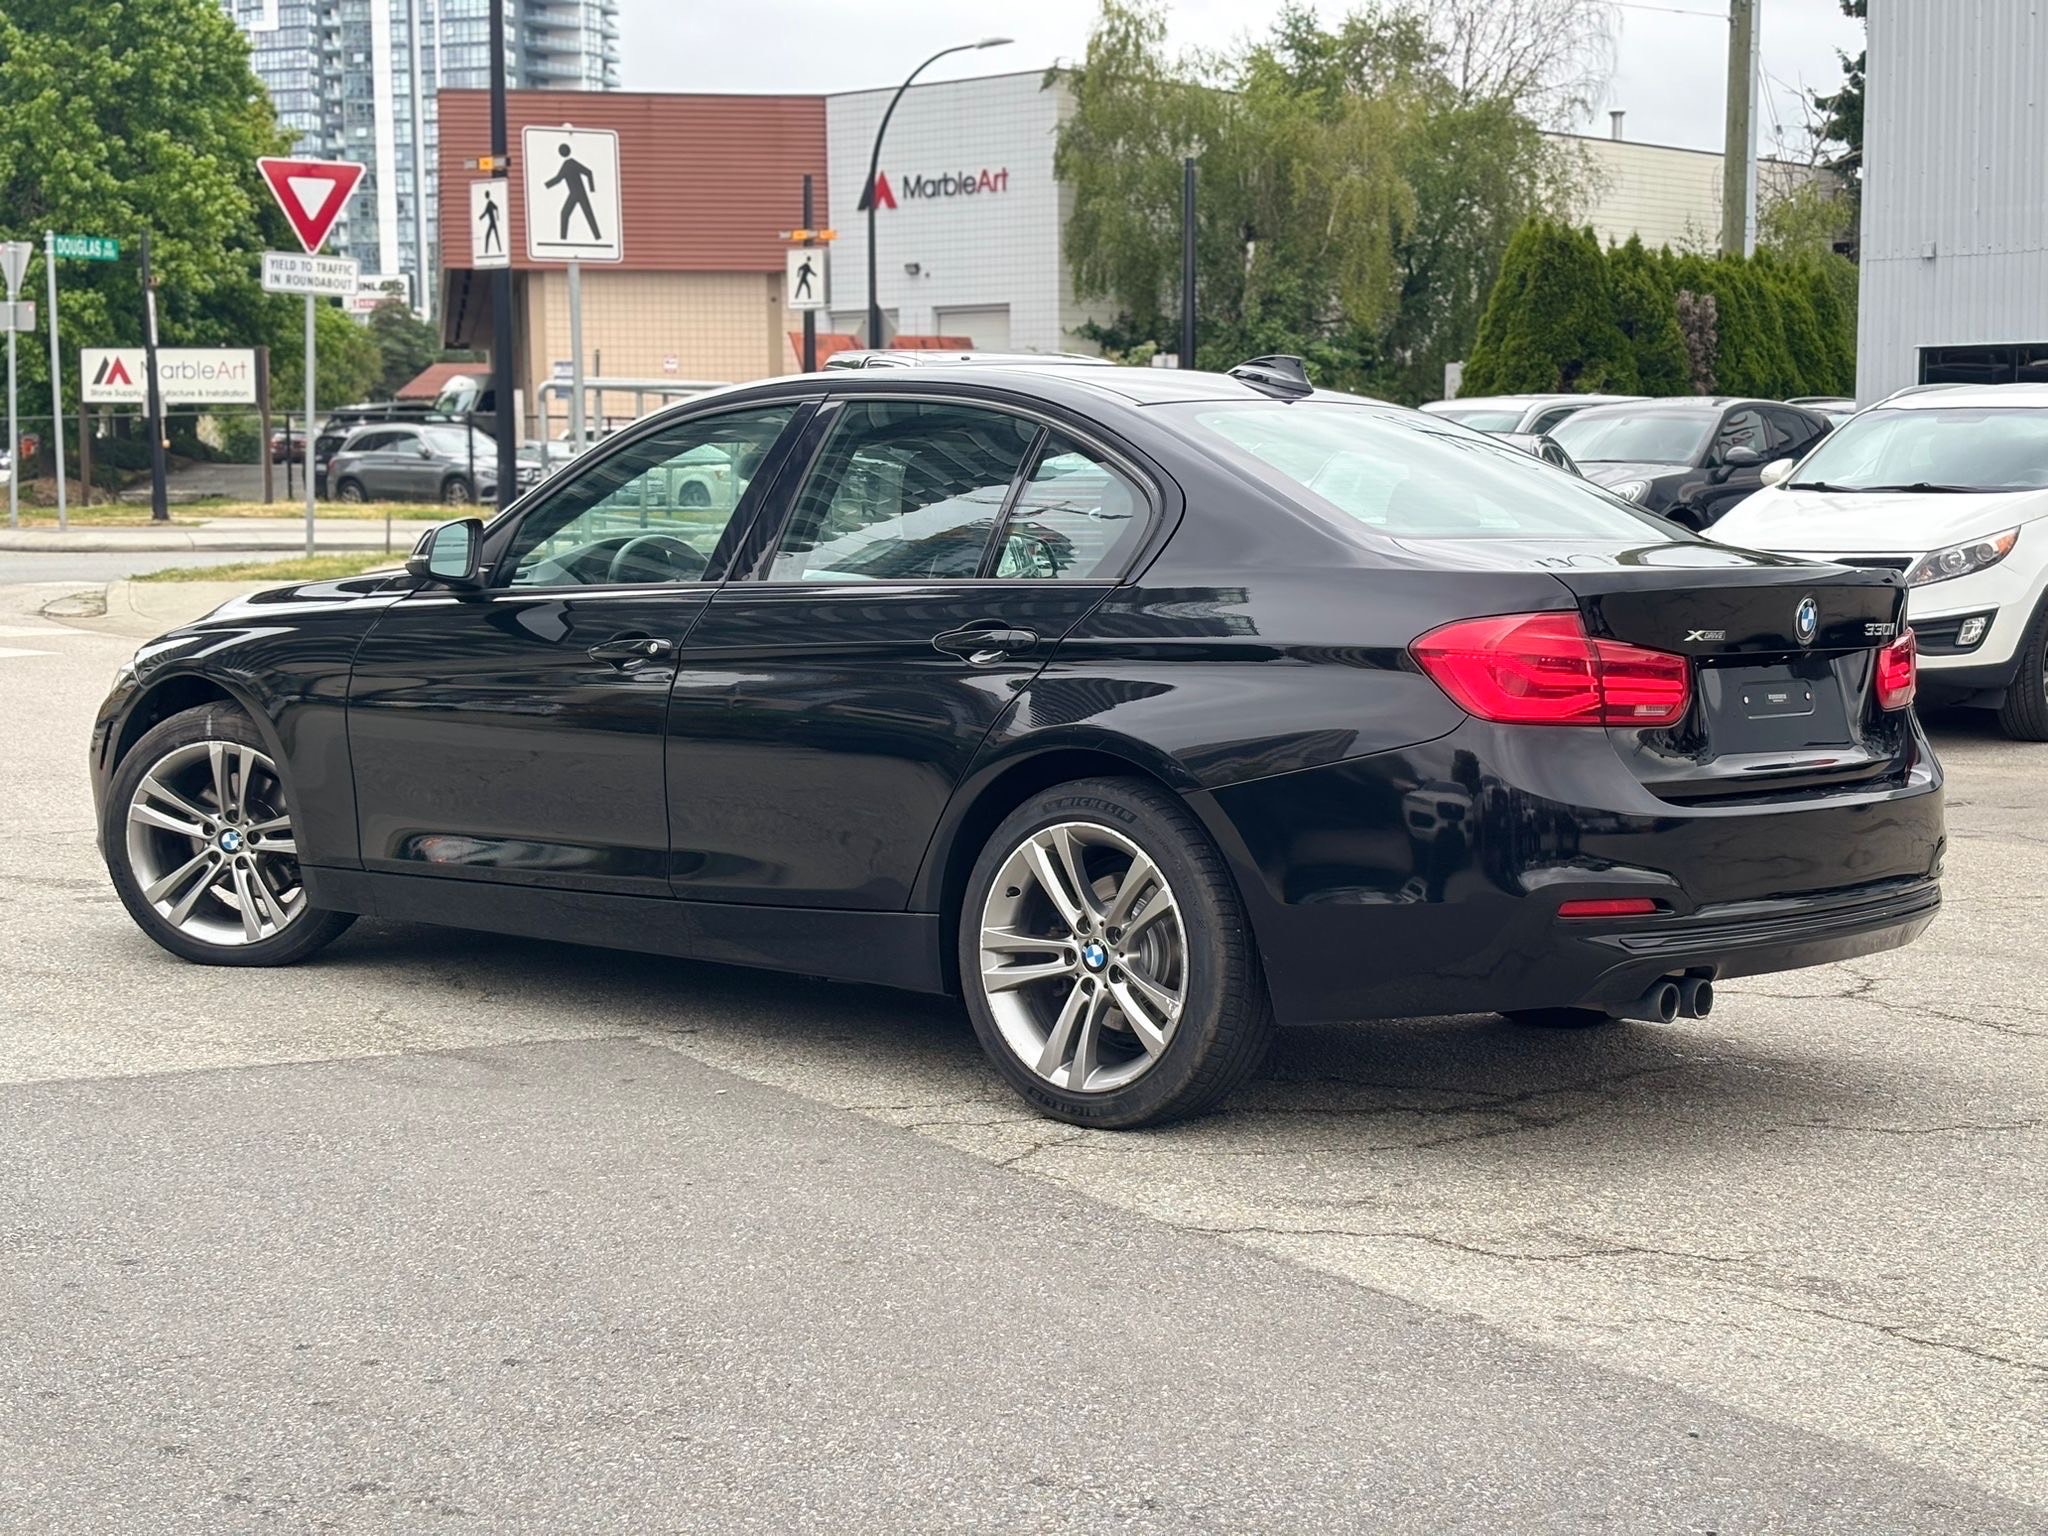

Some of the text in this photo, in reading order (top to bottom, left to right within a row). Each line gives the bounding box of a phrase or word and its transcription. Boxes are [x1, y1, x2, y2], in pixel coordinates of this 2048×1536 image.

[903, 167, 1008, 199] MarbleArt
[57, 238, 101, 257] DOUGLAS
[270, 259, 353, 276] YIELD TO TRAFFIC
[270, 274, 352, 290] IN ROUNDABOUT
[1060, 797, 1134, 822] MICHELIN
